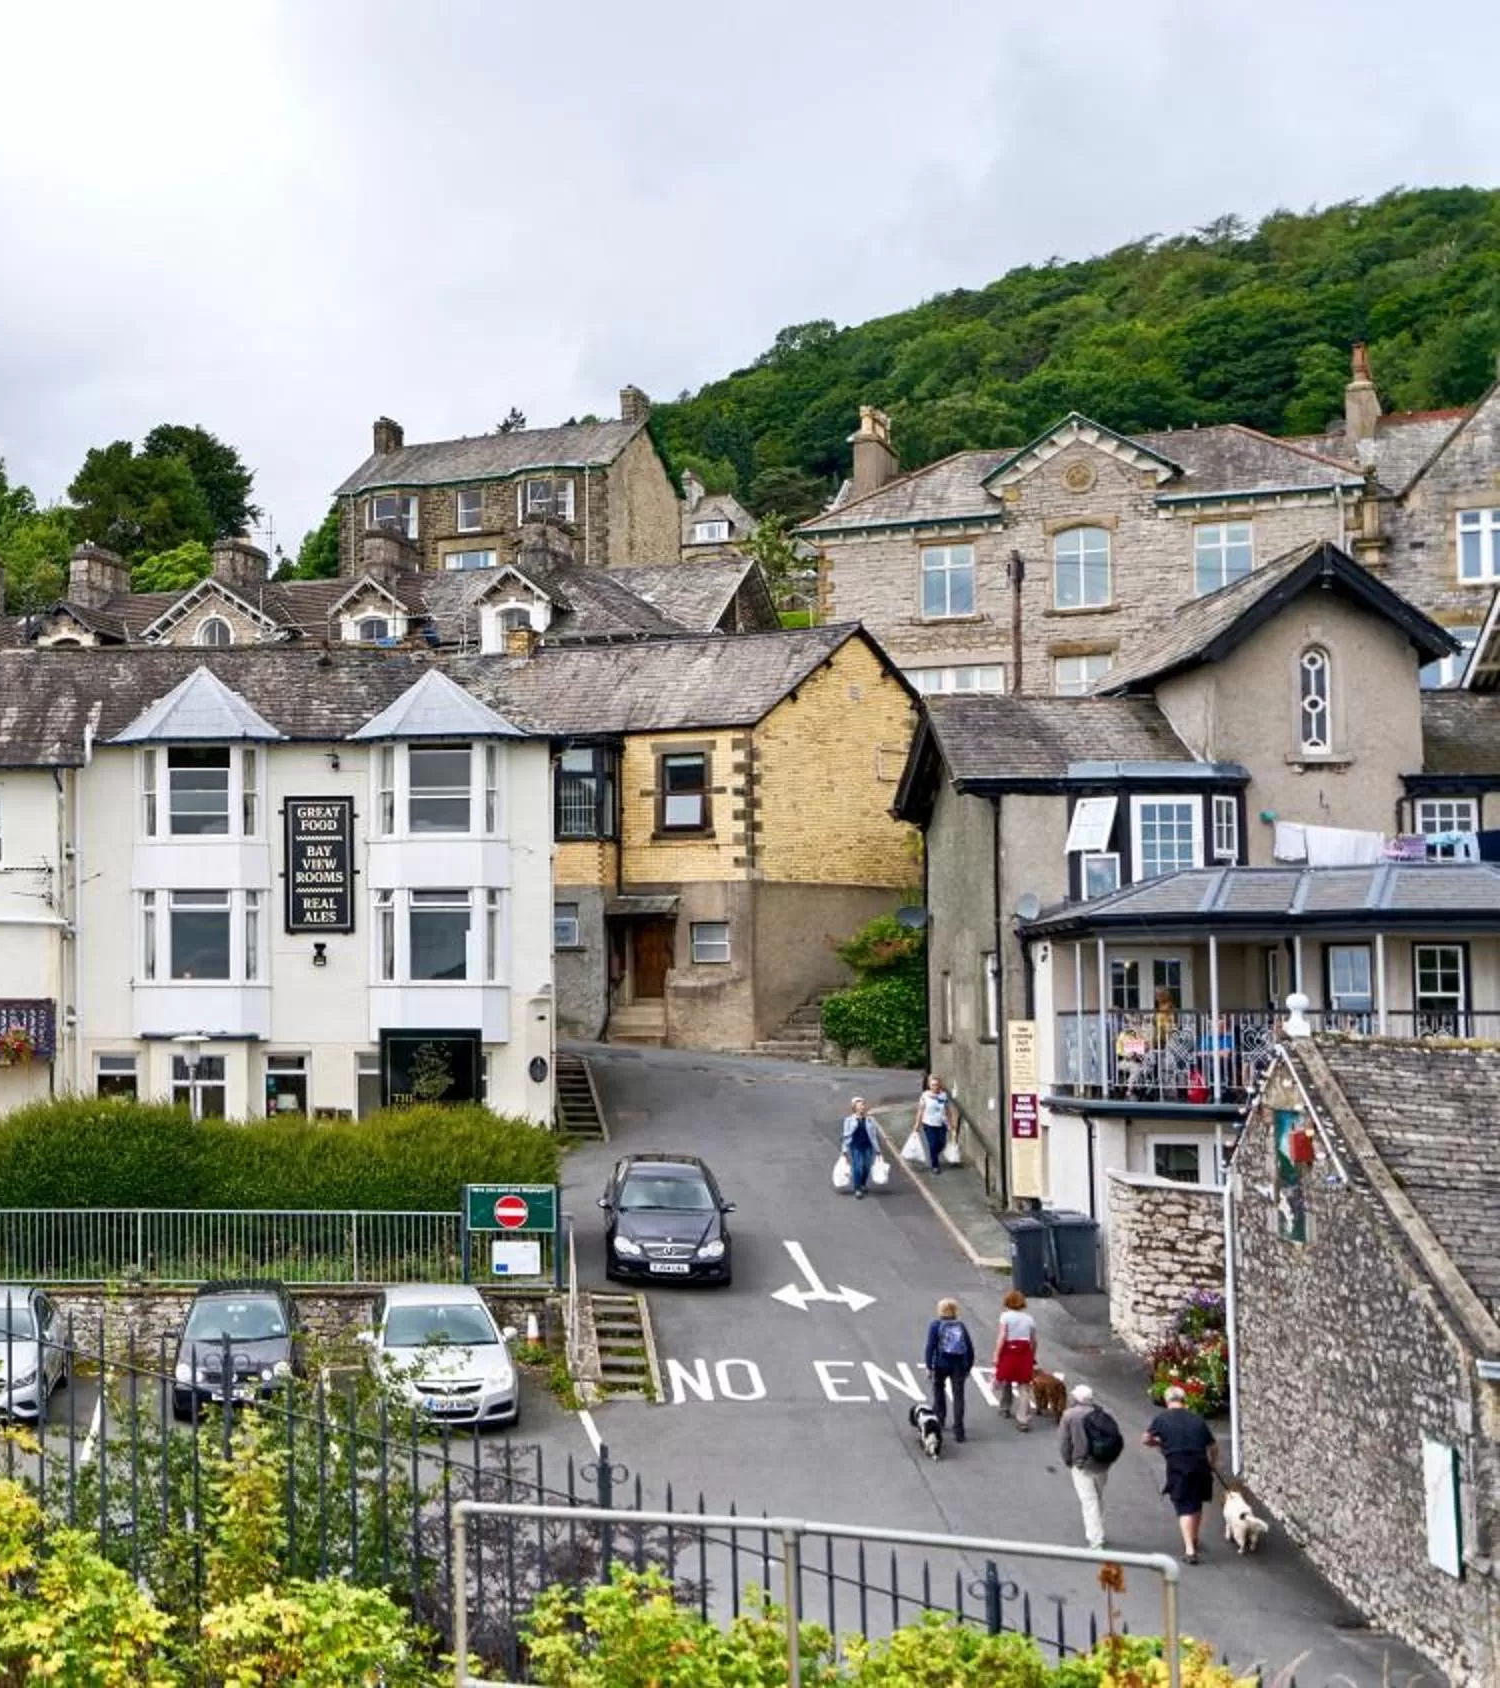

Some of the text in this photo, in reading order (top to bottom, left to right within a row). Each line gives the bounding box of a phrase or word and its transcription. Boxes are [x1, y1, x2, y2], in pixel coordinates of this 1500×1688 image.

[297, 806, 340, 818] GREAT
[301, 819, 337, 831] FOOD
[306, 845, 333, 857] BAY
[302, 858, 337, 870] VIEW
[296, 871, 344, 883] ROOMS
[303, 897, 337, 909] REAL
[303, 911, 337, 923] ALES
[666, 1358, 1065, 1408] NO ENR
